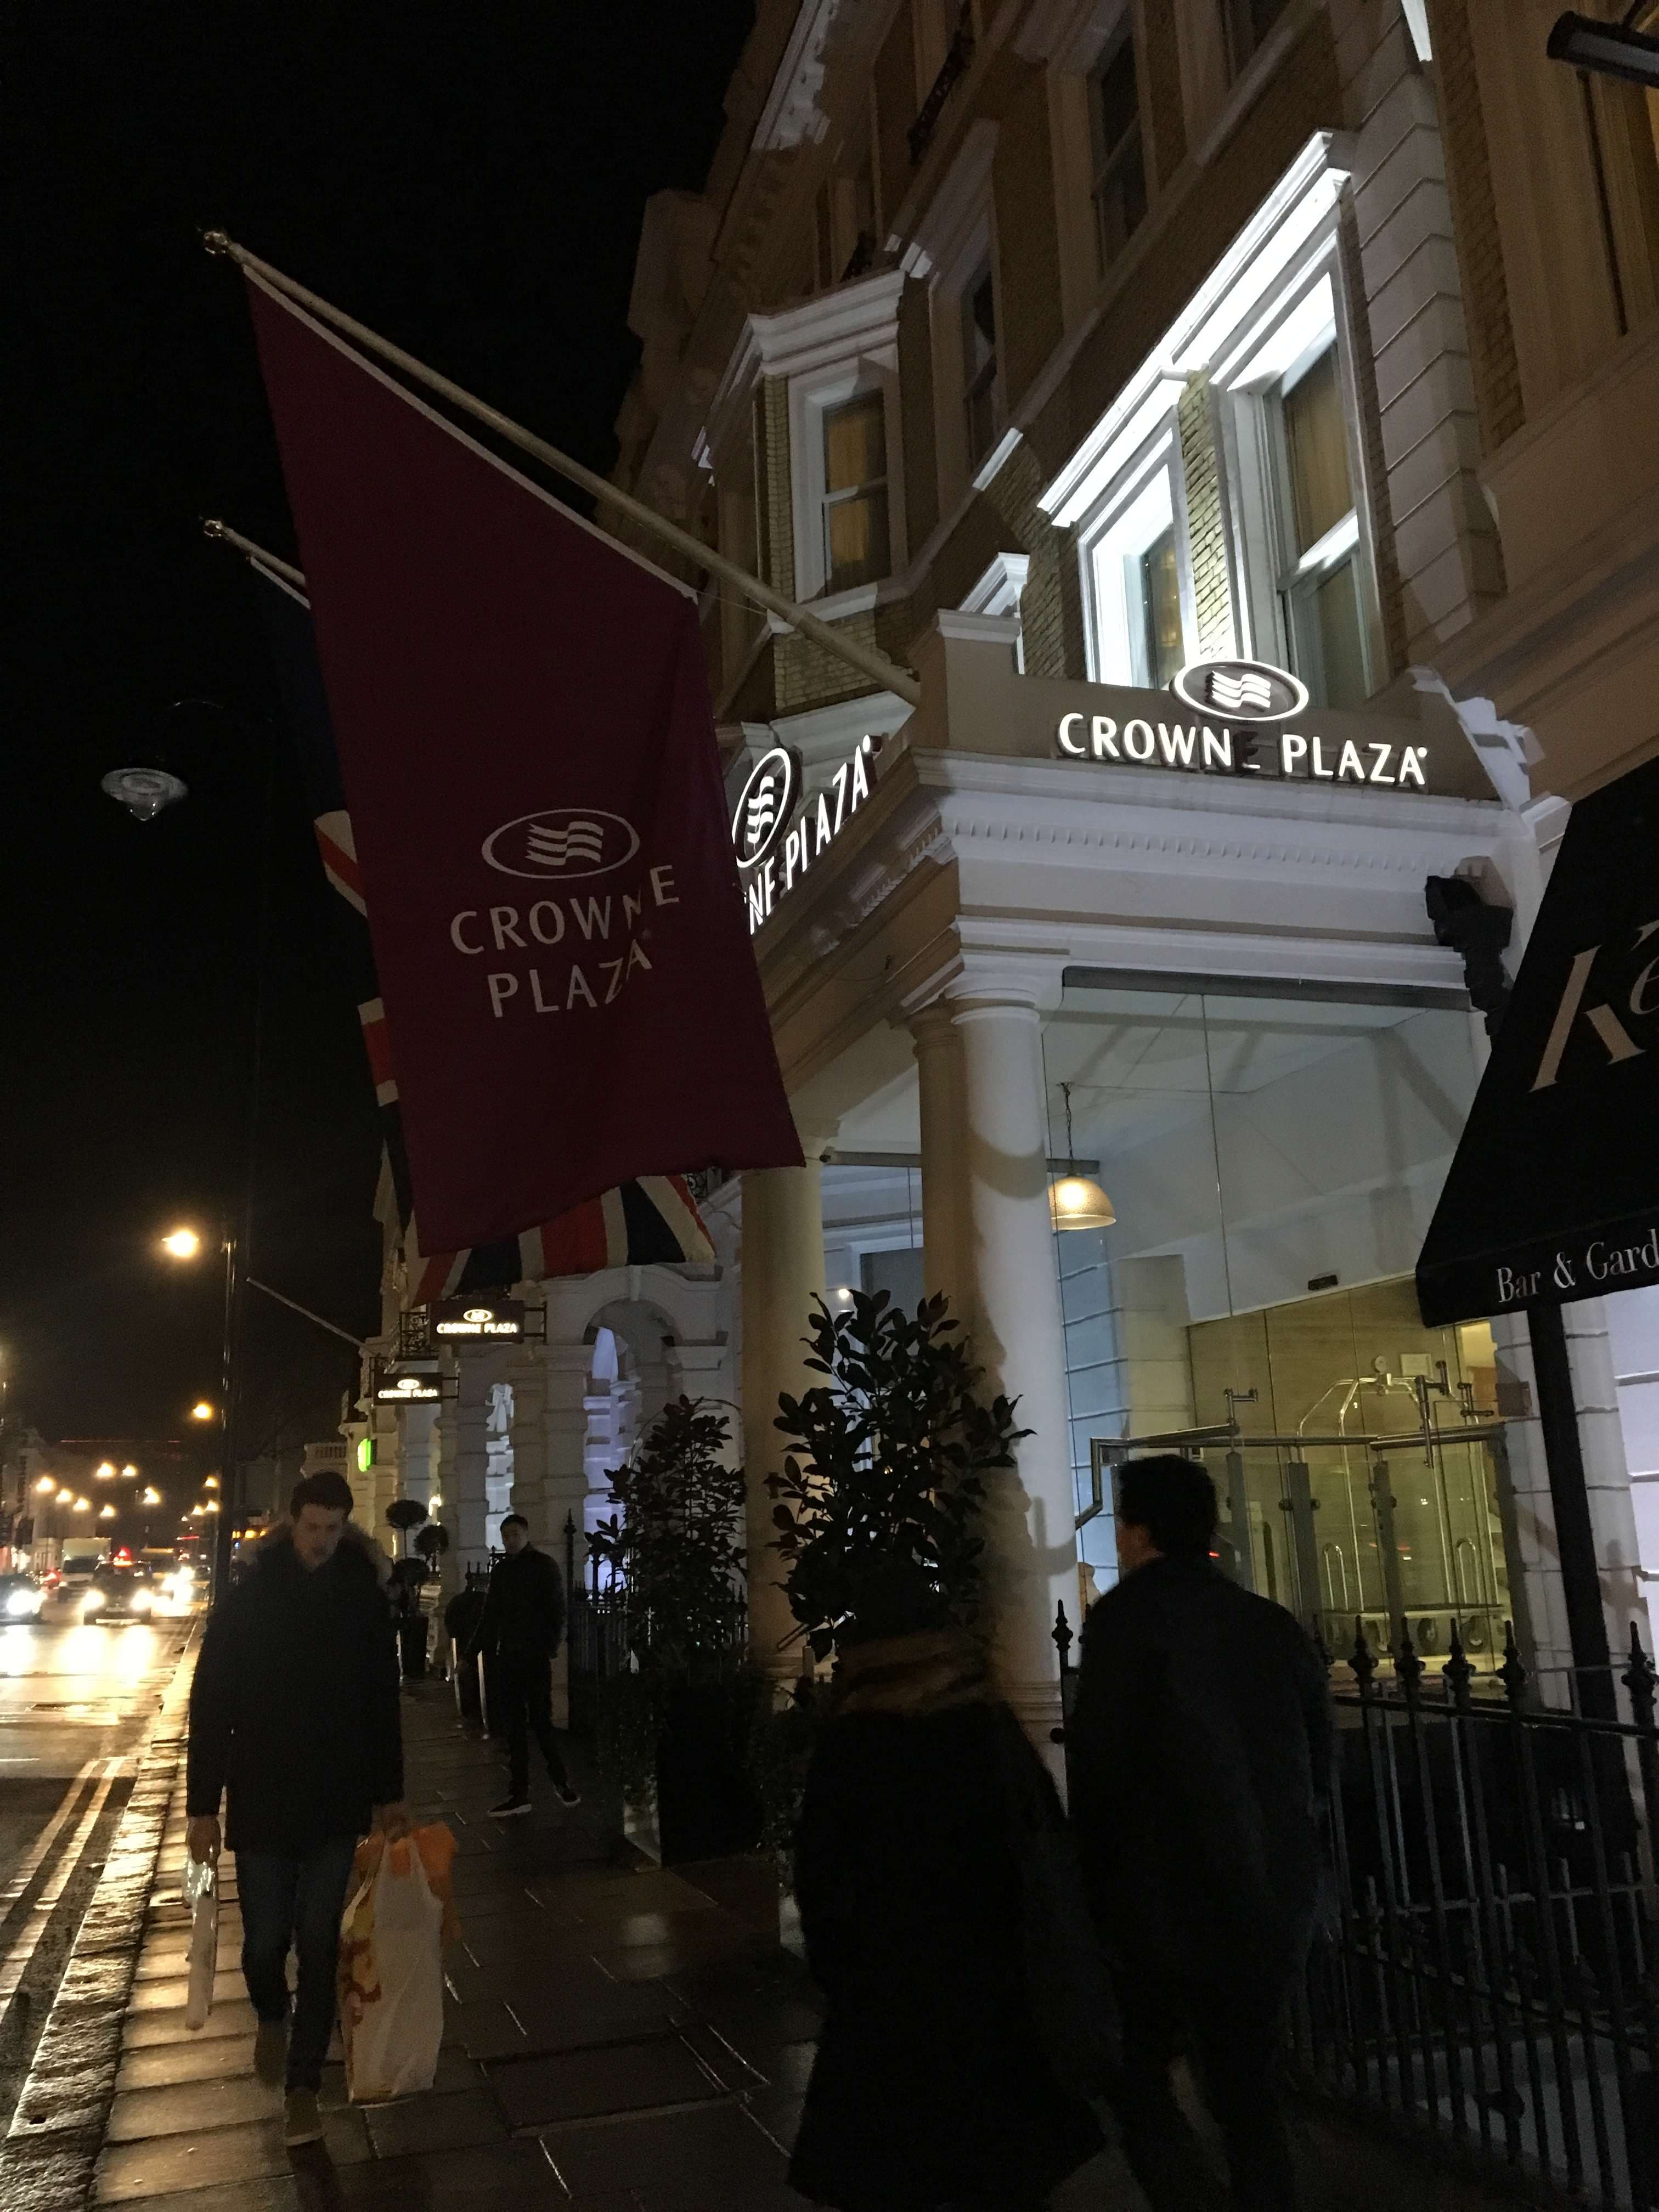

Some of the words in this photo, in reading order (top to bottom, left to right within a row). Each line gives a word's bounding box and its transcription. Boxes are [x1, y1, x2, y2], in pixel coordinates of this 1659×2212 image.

[1058, 712, 1261, 771] CROWNE
[1282, 733, 1426, 785] PLAZA
[450, 865, 680, 955] CROWNE
[487, 939, 653, 1018] PLAZA
[1496, 1267, 1541, 1303] Bar
[1554, 1251, 1576, 1289] &
